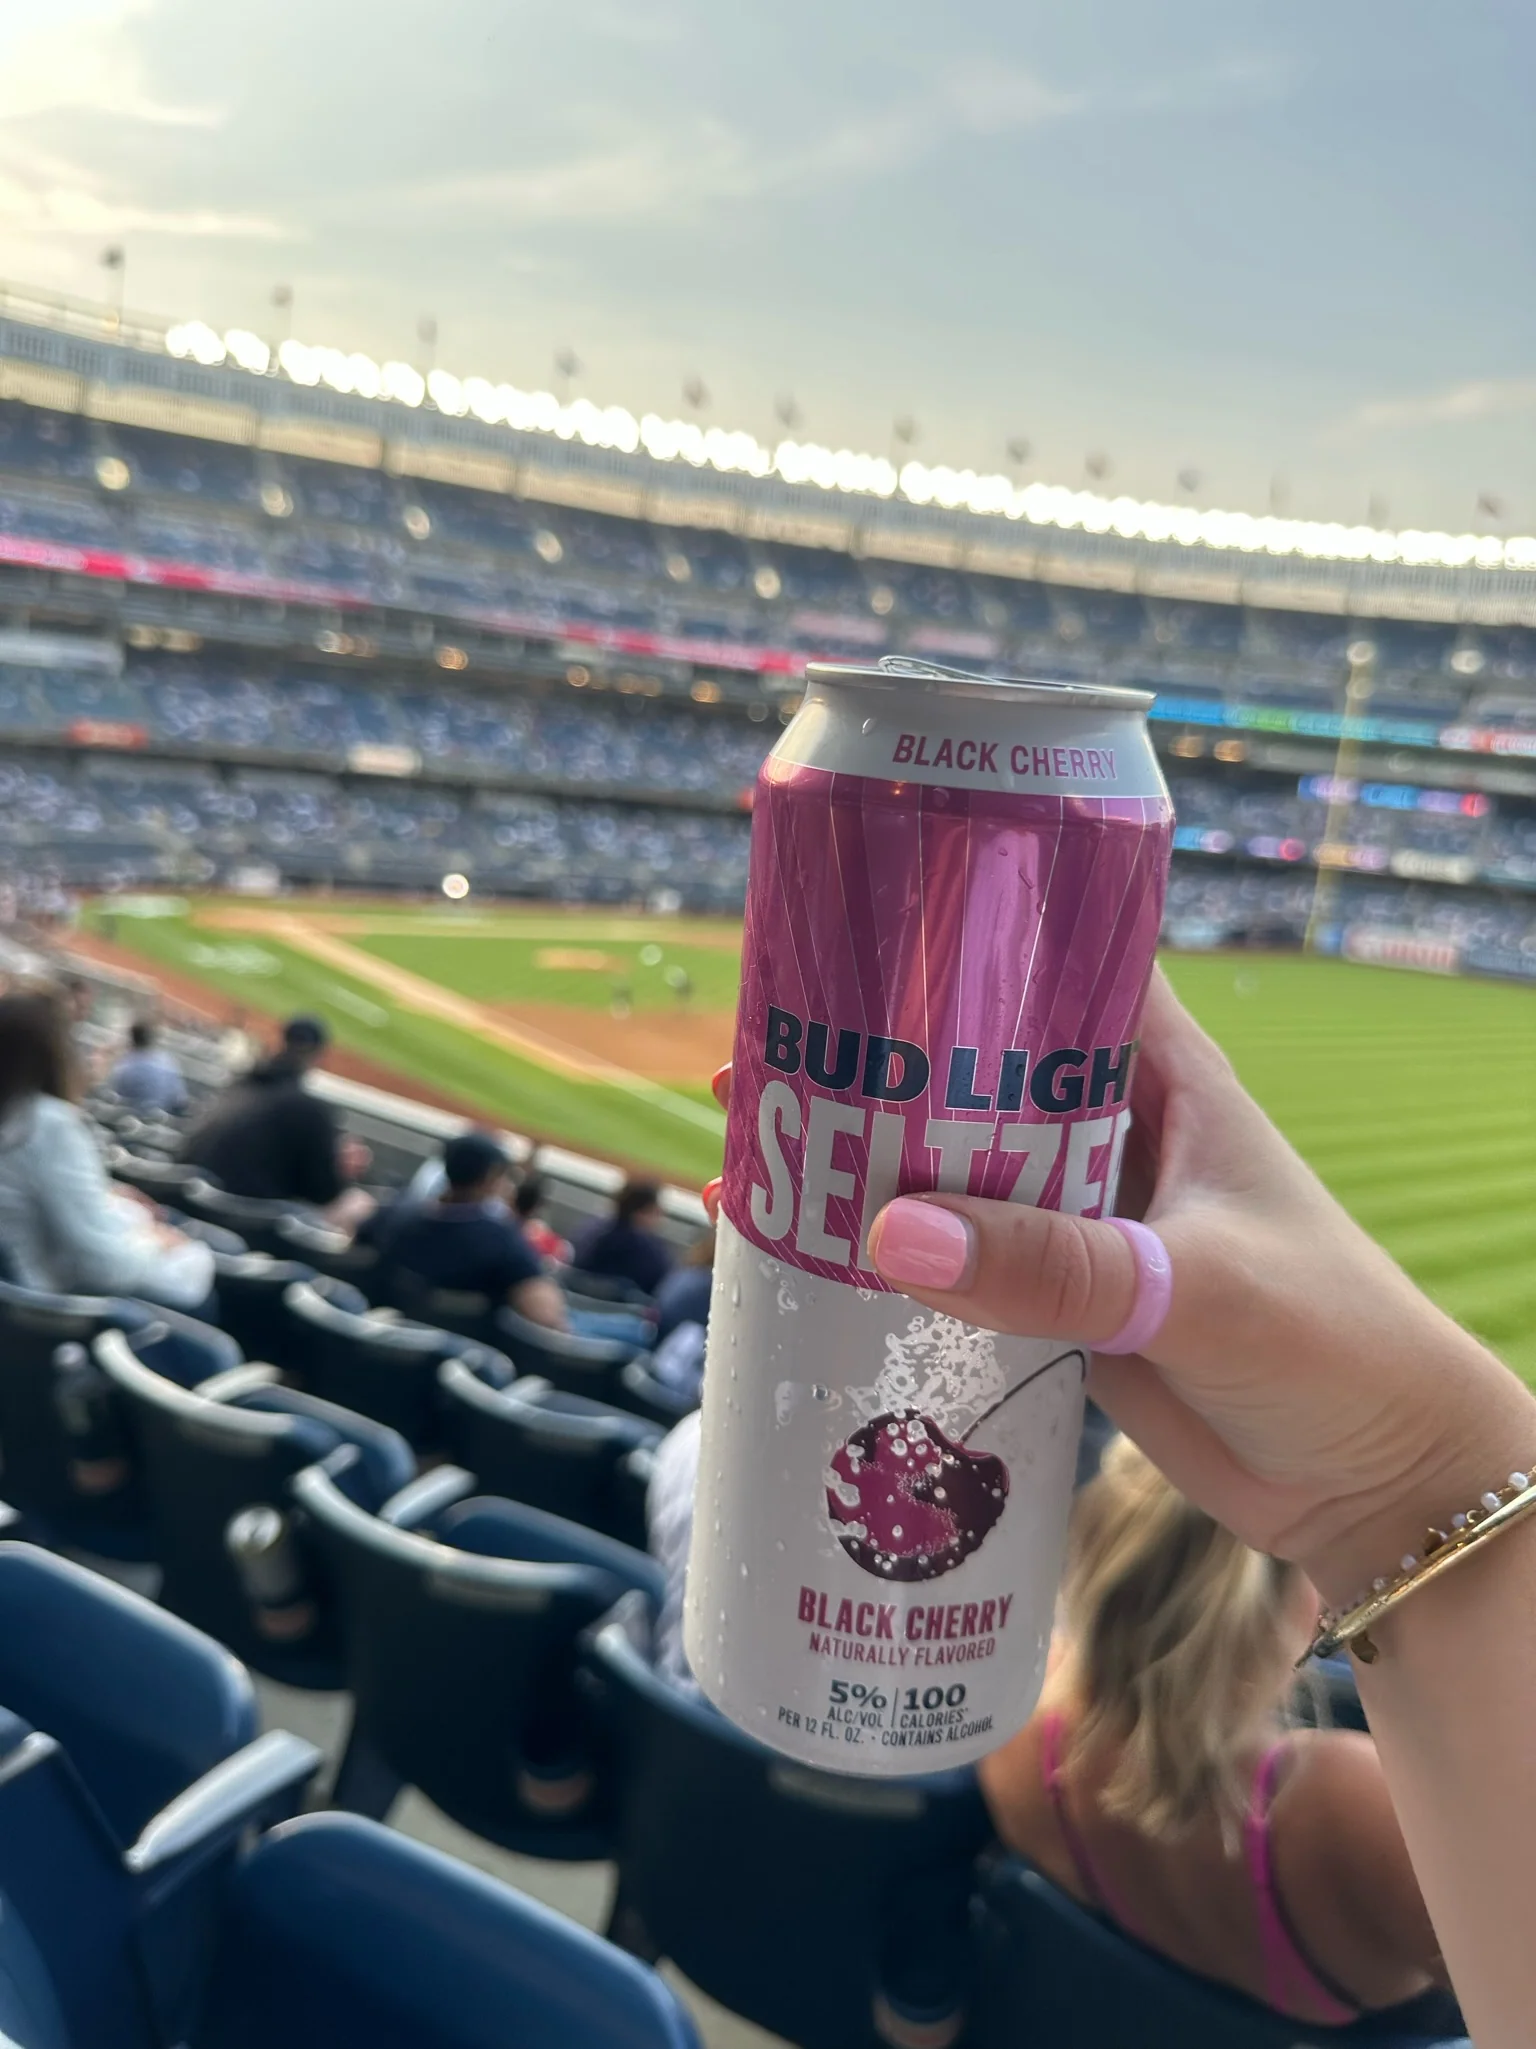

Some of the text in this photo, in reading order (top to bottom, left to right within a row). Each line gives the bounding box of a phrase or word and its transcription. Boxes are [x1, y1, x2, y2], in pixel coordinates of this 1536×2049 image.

[892, 734, 1117, 780] BLACK CHERRY
[763, 1004, 1140, 1114] BUD LIGH
[797, 1585, 1014, 1641] BLACK CHERRY
[809, 1631, 996, 1667] NATURALLY FLAVORED
[829, 1679, 967, 1711] 5% 100
[778, 1705, 994, 1747] PER 12 FL. OZ. CONTAINS ALCOHOL
[827, 1705, 883, 1728] ALC/VOL
